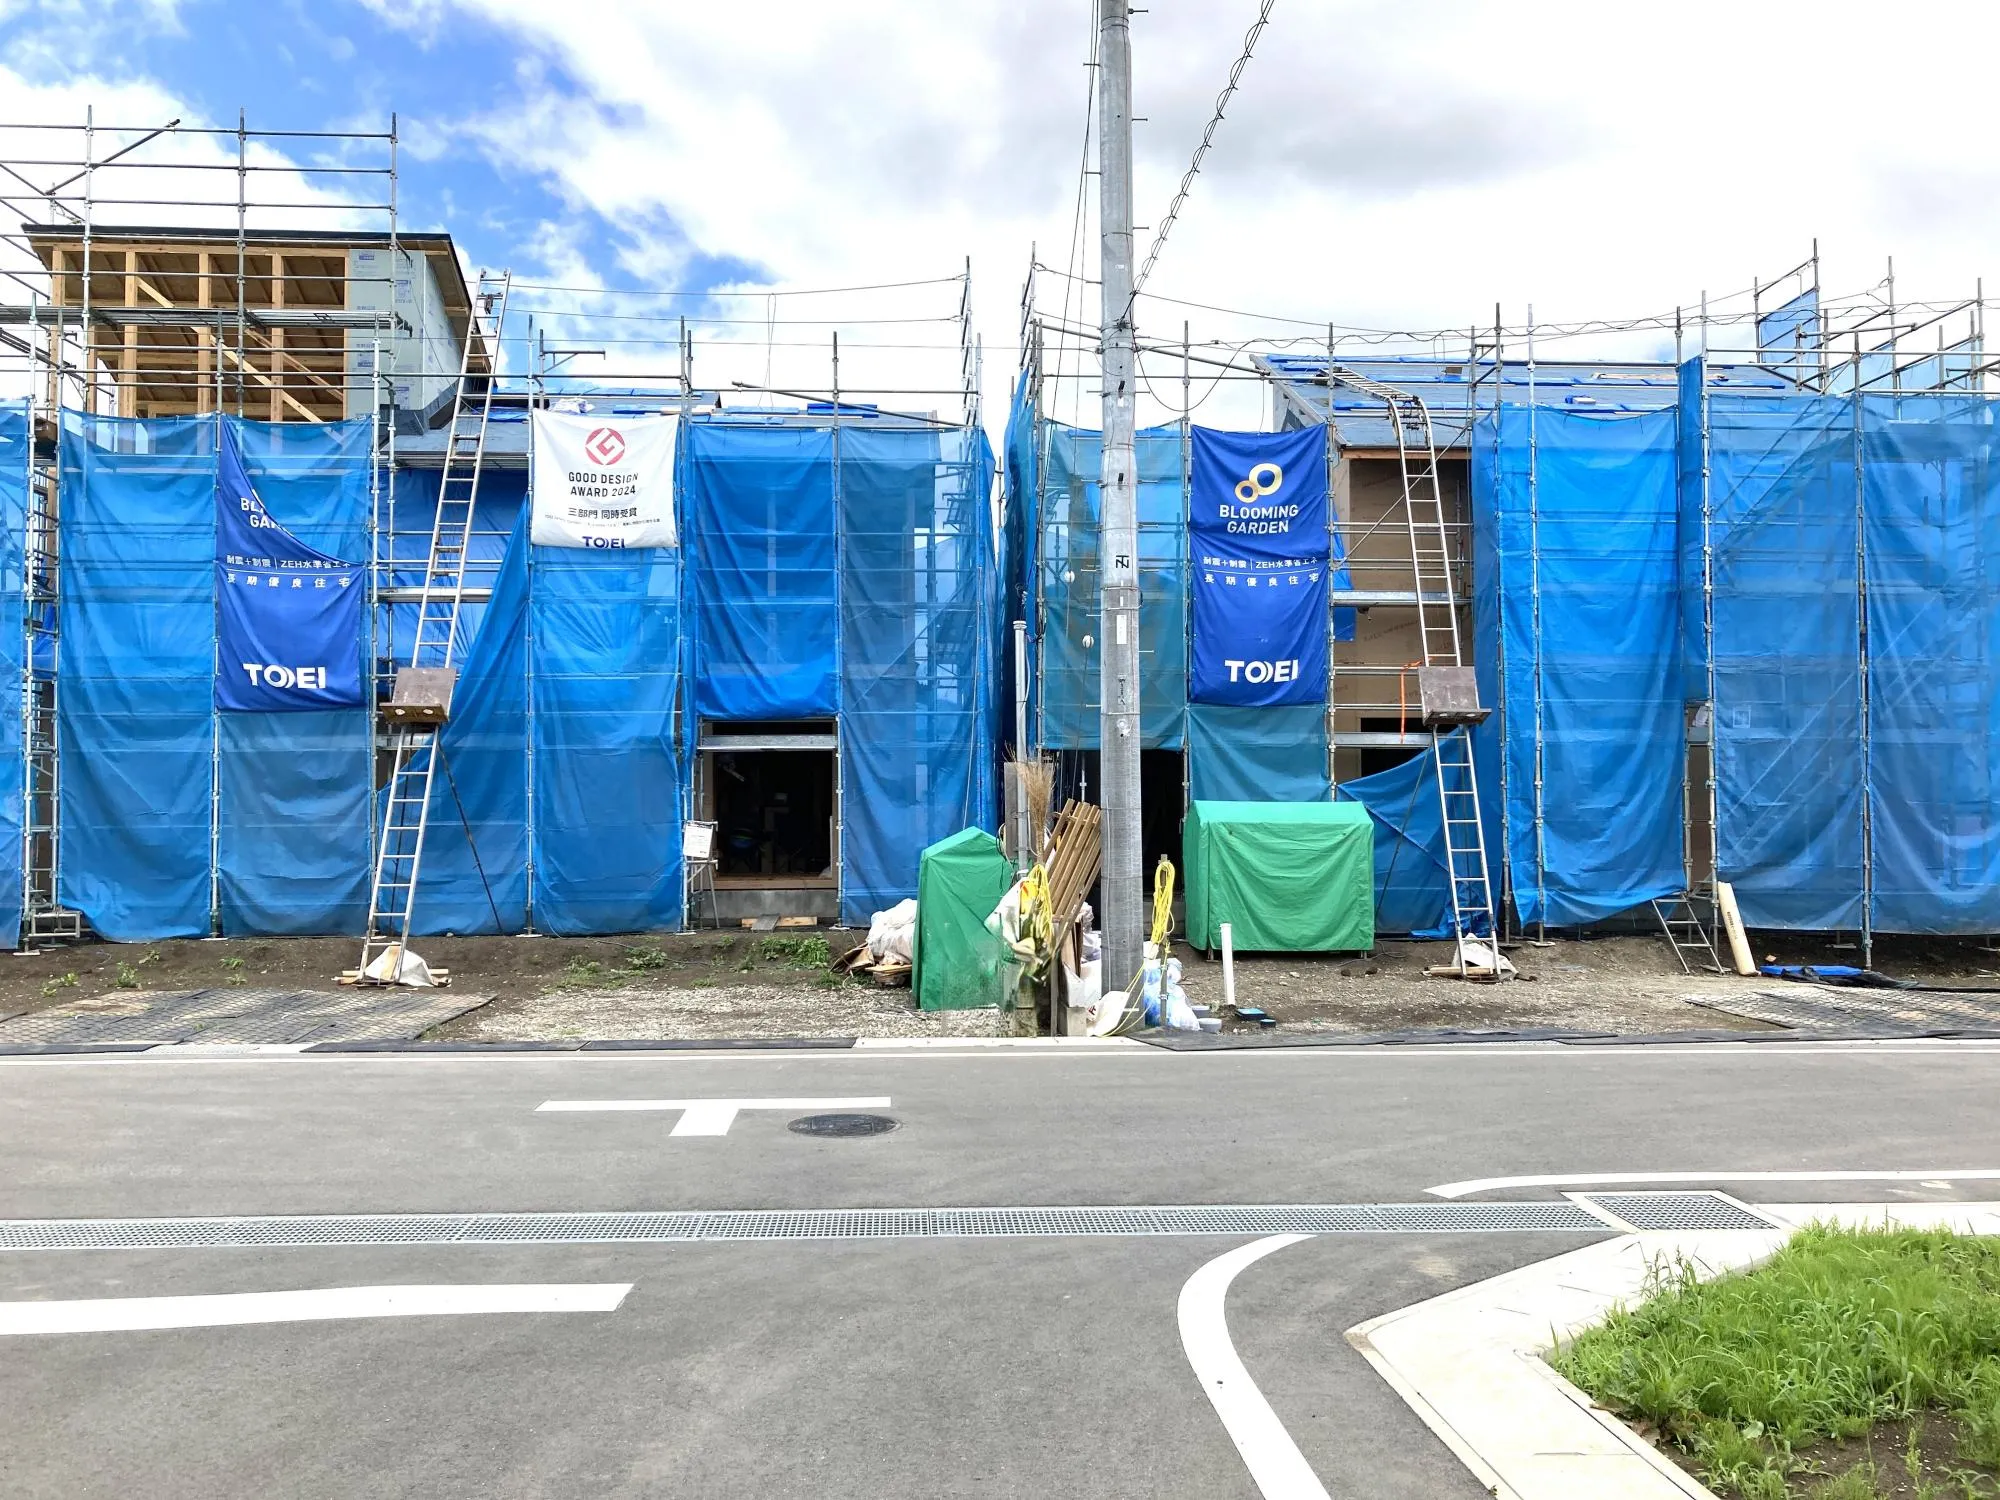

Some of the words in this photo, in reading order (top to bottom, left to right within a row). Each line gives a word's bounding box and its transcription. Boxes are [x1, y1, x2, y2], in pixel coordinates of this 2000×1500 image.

[568, 471, 598, 483] GOOD
[600, 472, 639, 485] DESIGN
[570, 486, 609, 498] AWARD
[611, 484, 636, 497] 2024
[240, 497, 264, 514] BL
[1219, 504, 1299, 520] BLOOMING
[1226, 519, 1290, 535] GARDEN
[582, 535, 626, 549] TOEI
[1204, 572, 1320, 588] 長期優良住宅
[242, 662, 328, 690] TOEI
[1224, 659, 1300, 684] TOEI
